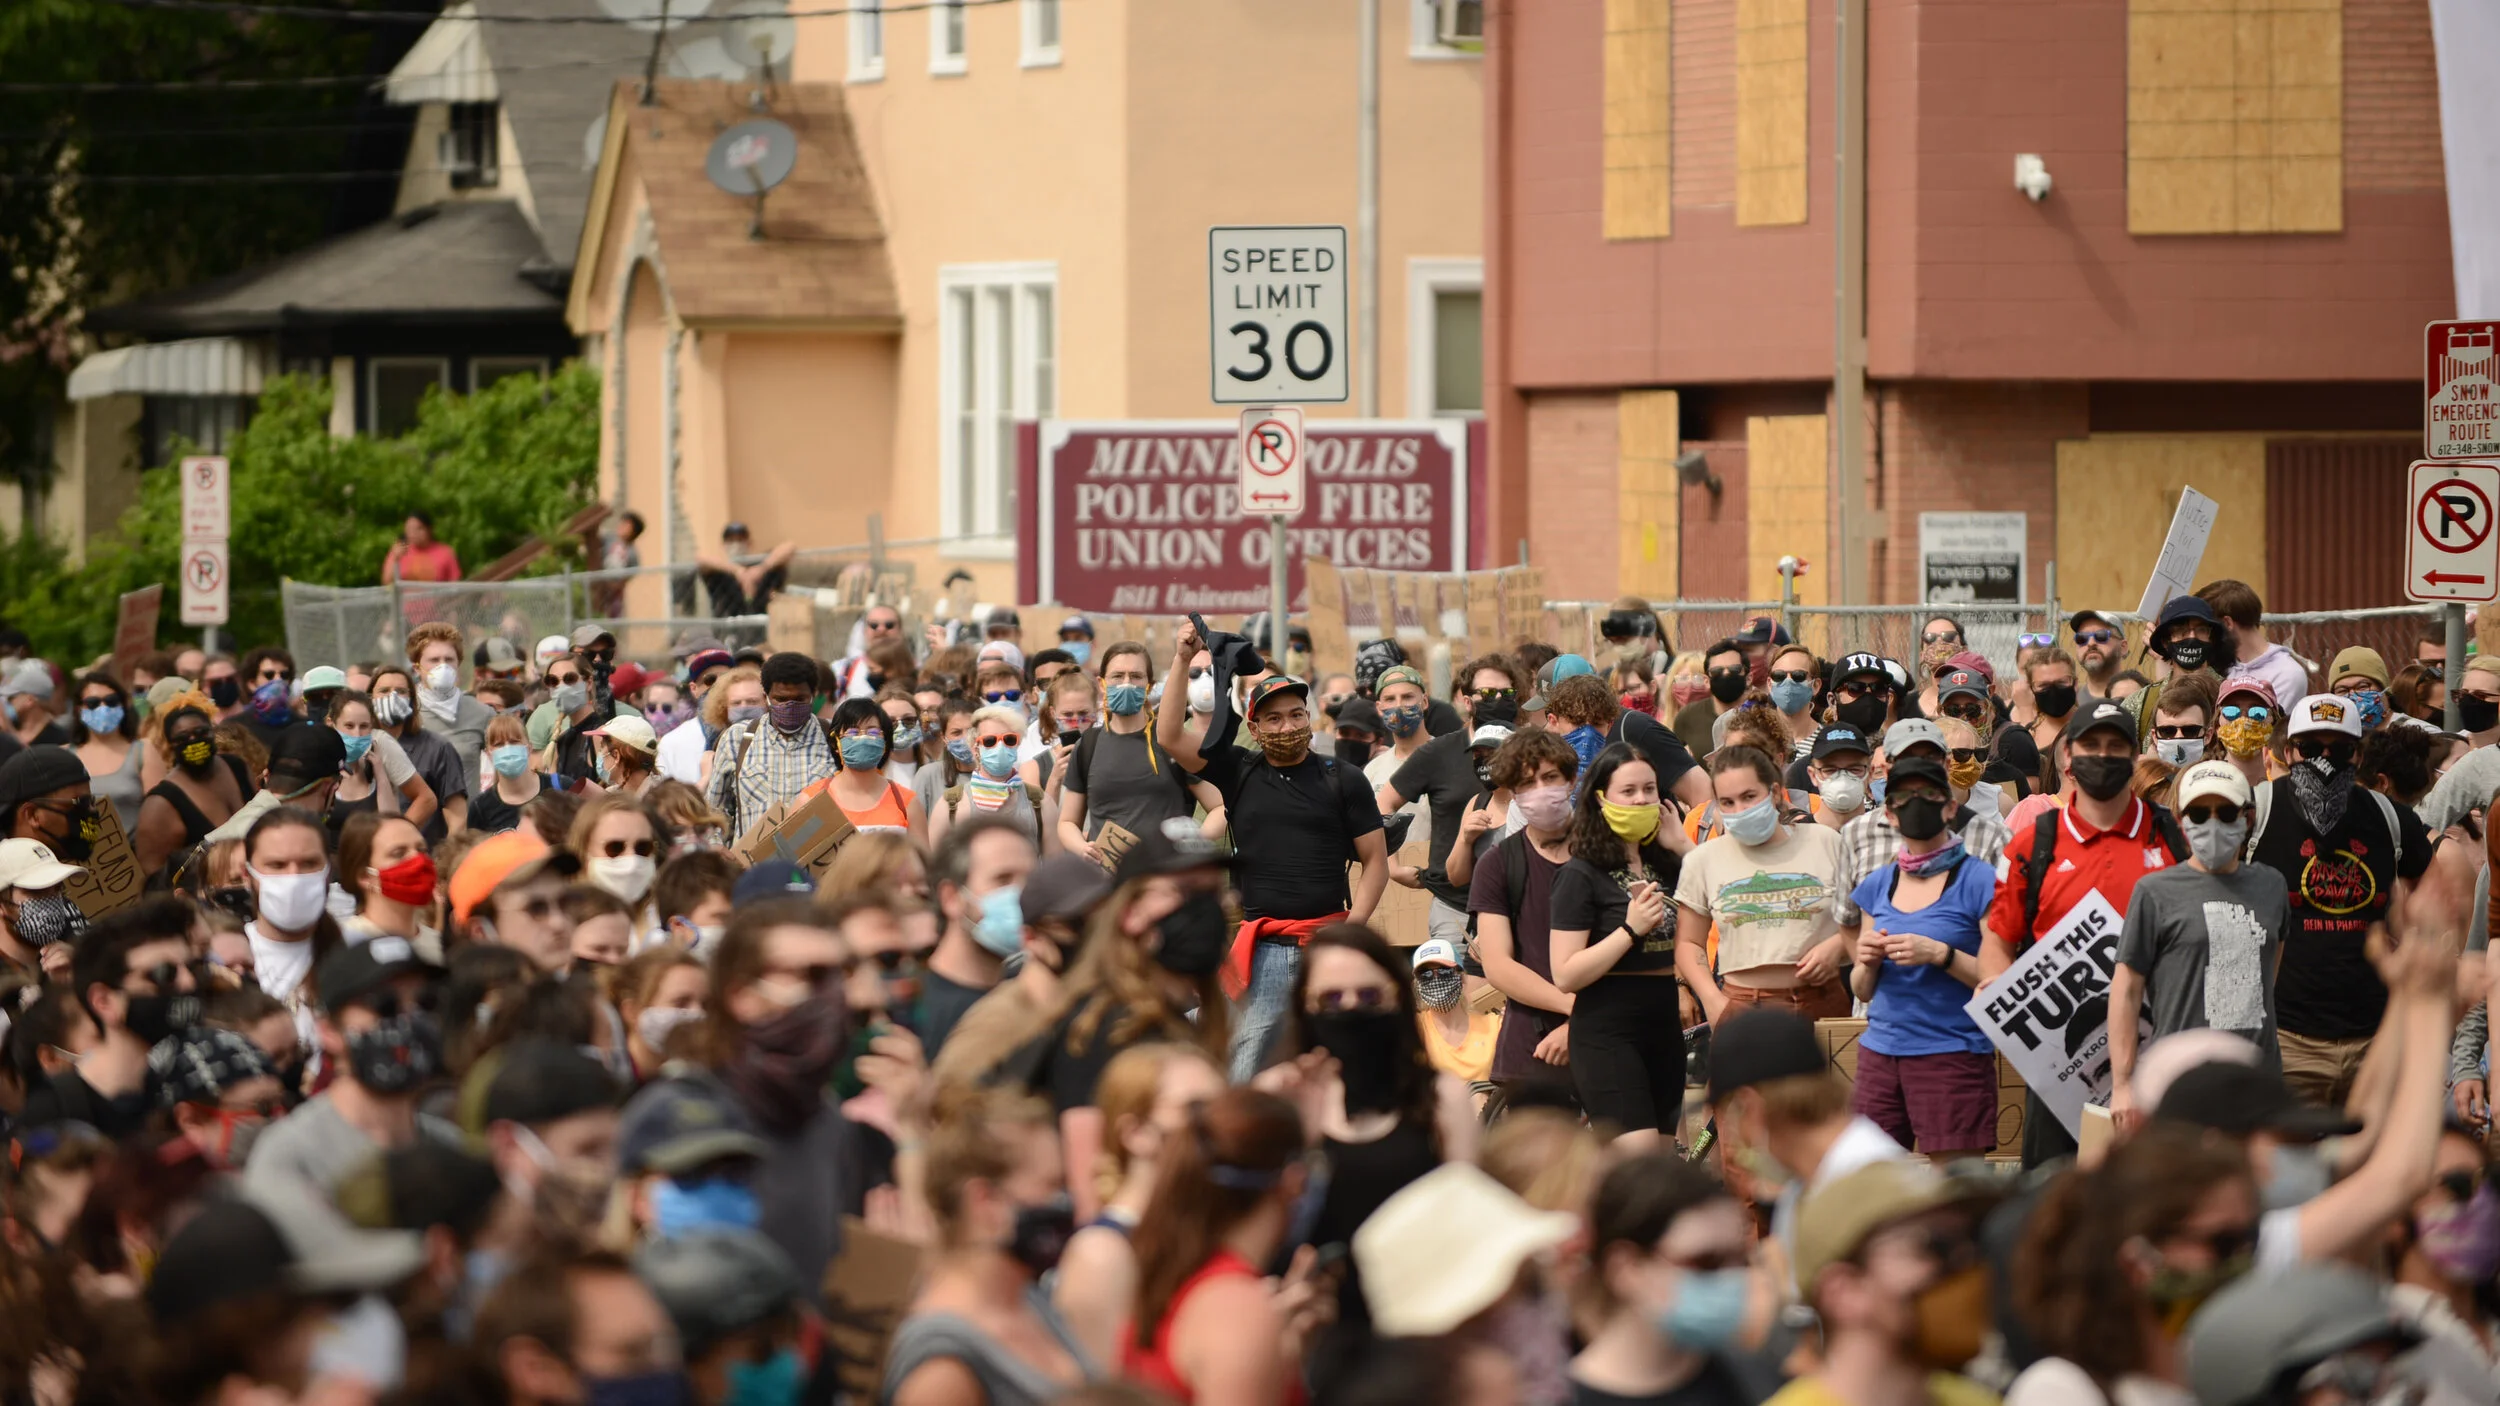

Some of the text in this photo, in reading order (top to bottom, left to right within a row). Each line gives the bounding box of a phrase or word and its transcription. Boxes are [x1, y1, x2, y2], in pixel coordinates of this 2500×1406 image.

[1222, 248, 1335, 273] SPEED
[1235, 284, 1322, 309] LIMIT
[1227, 320, 1333, 382] 30
[2451, 383, 2490, 402] SNOW
[2433, 403, 2500, 421] EMERGENC
[2449, 423, 2492, 441] ROUTE
[1075, 482, 1433, 523] POLICE FIRE
[1077, 527, 1225, 569] UNION
[1928, 566, 1985, 581] TOWED
[1985, 909, 2107, 1024] FLUSH THIS
[2000, 934, 2121, 1052] TURD
[2057, 1058, 2084, 1083] BOB
